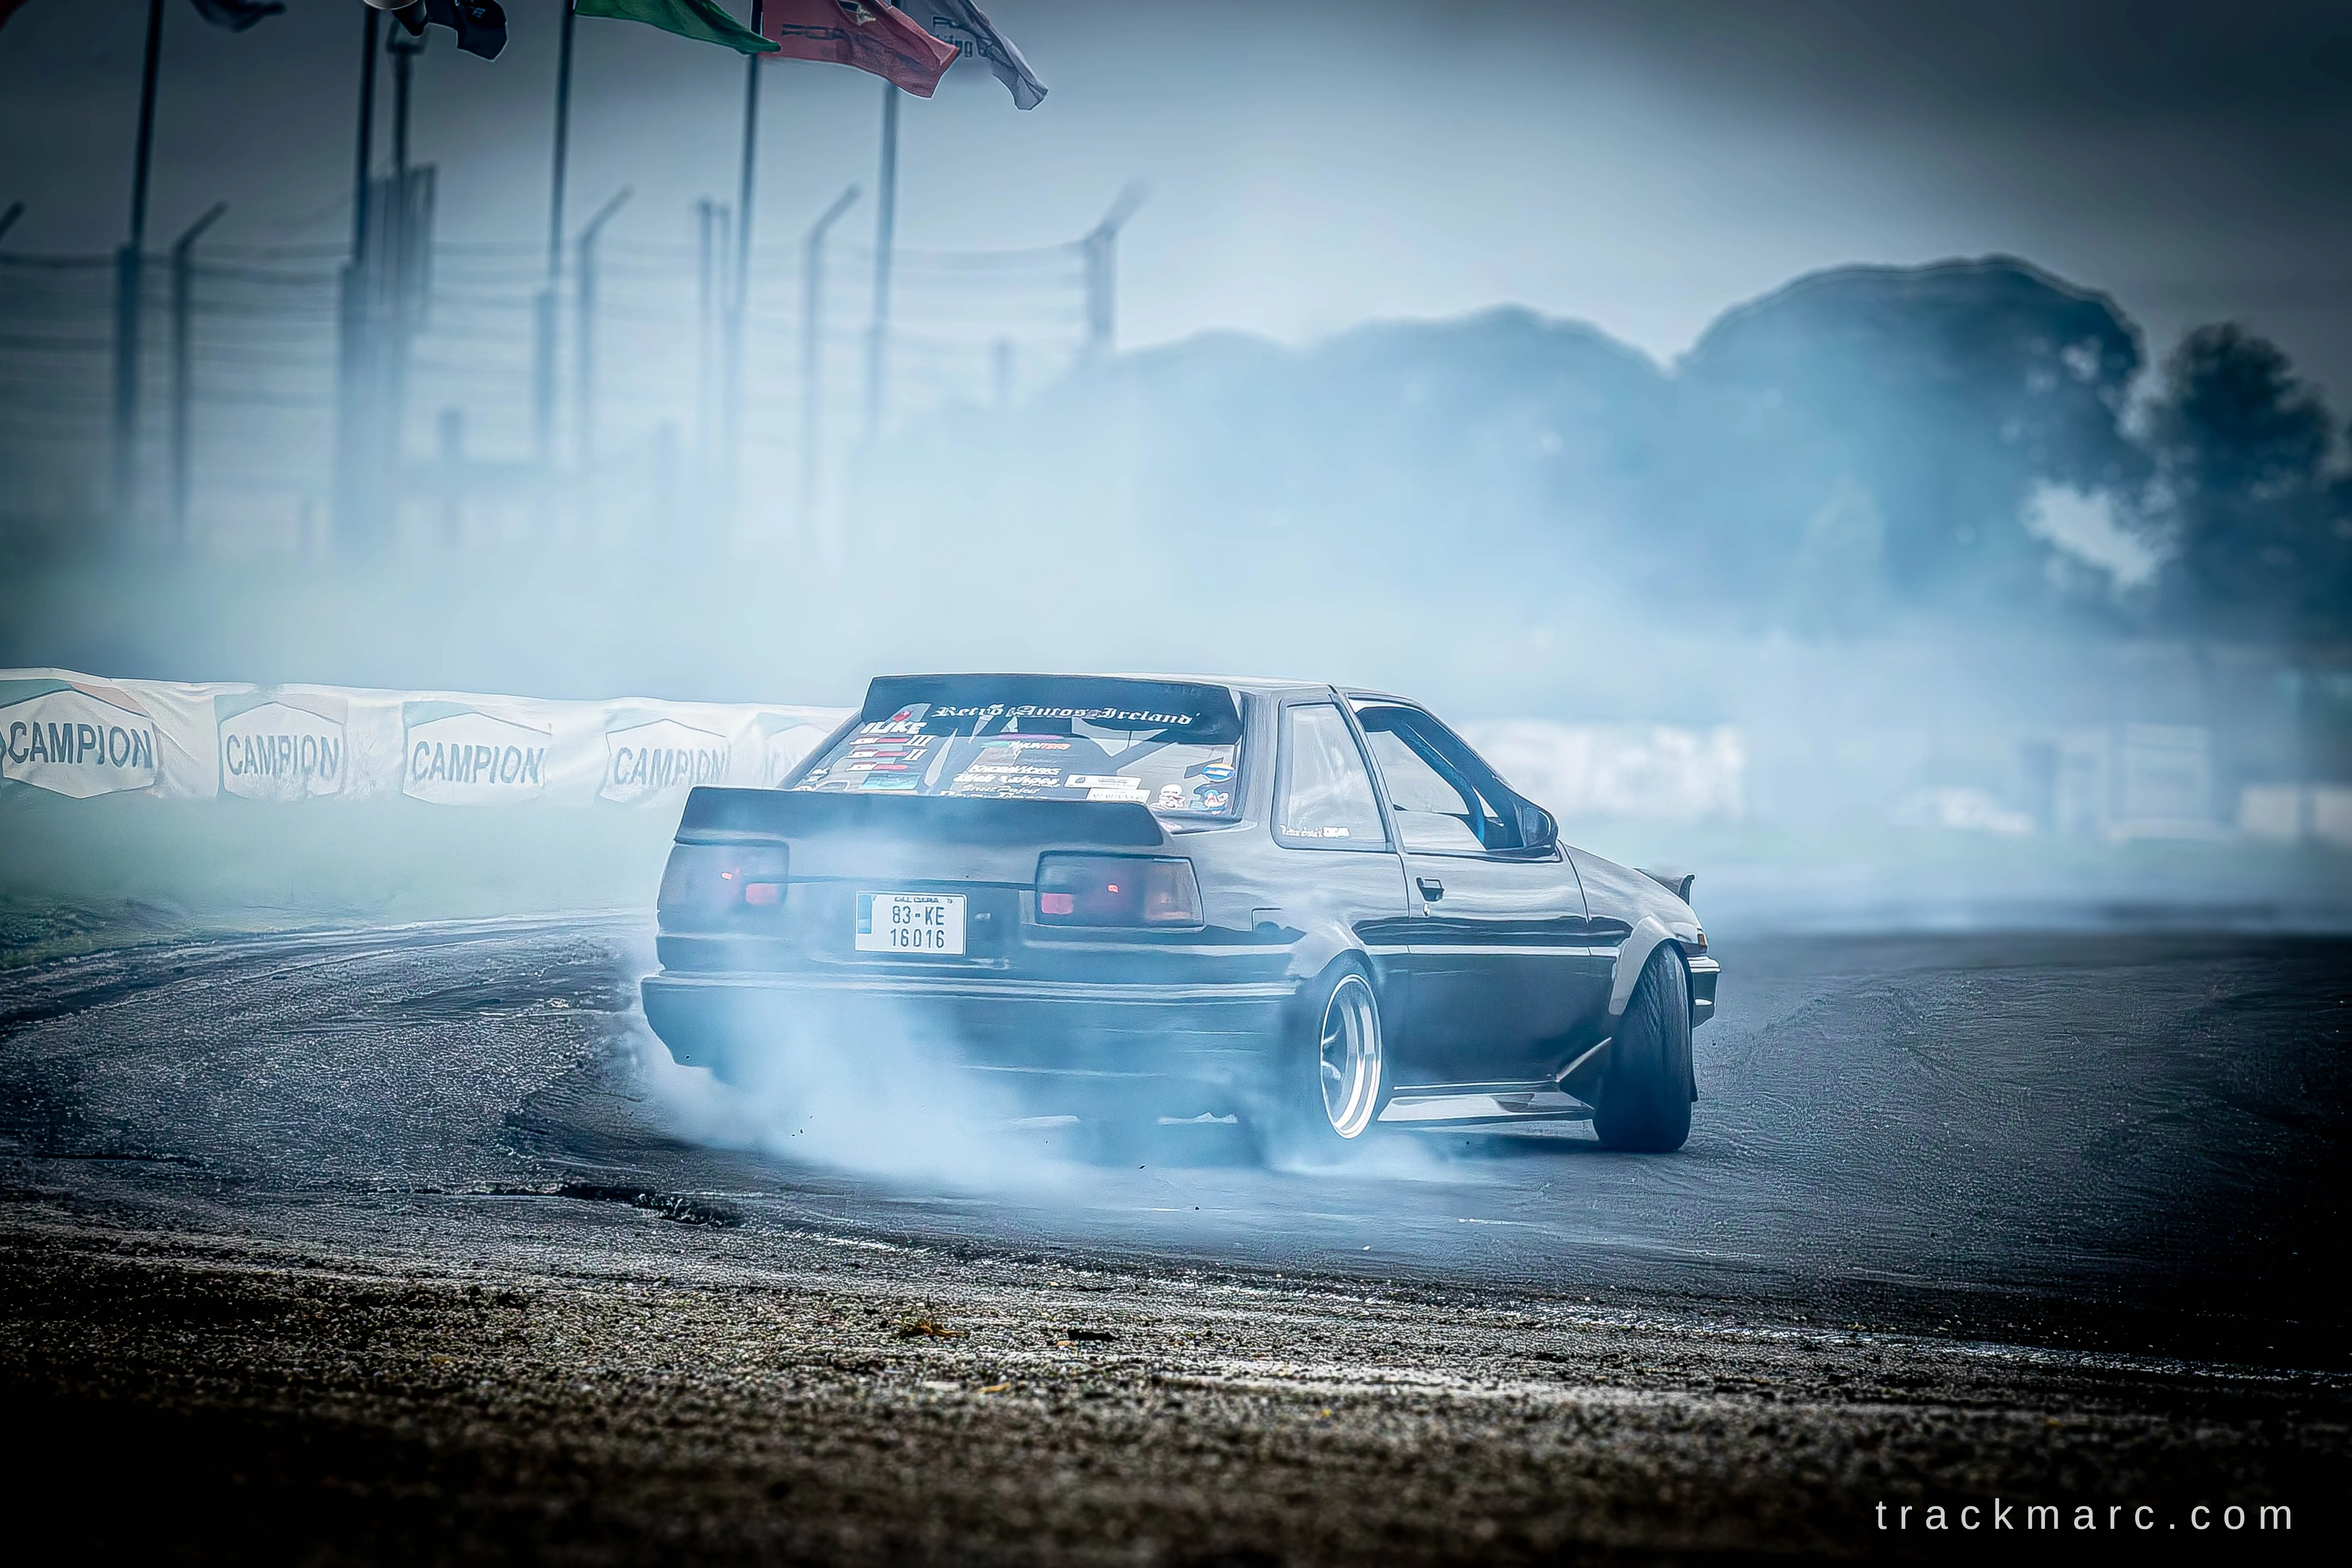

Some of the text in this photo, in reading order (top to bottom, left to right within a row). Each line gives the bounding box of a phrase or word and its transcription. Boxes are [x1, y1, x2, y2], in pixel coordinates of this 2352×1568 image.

[7, 720, 153, 769] CAMPION
[225, 734, 339, 780] CAMPION
[411, 741, 545, 785] CAMPION
[613, 747, 732, 786] CAMPION
[892, 905, 945, 926] 83-KE
[890, 928, 945, 948] 16016
